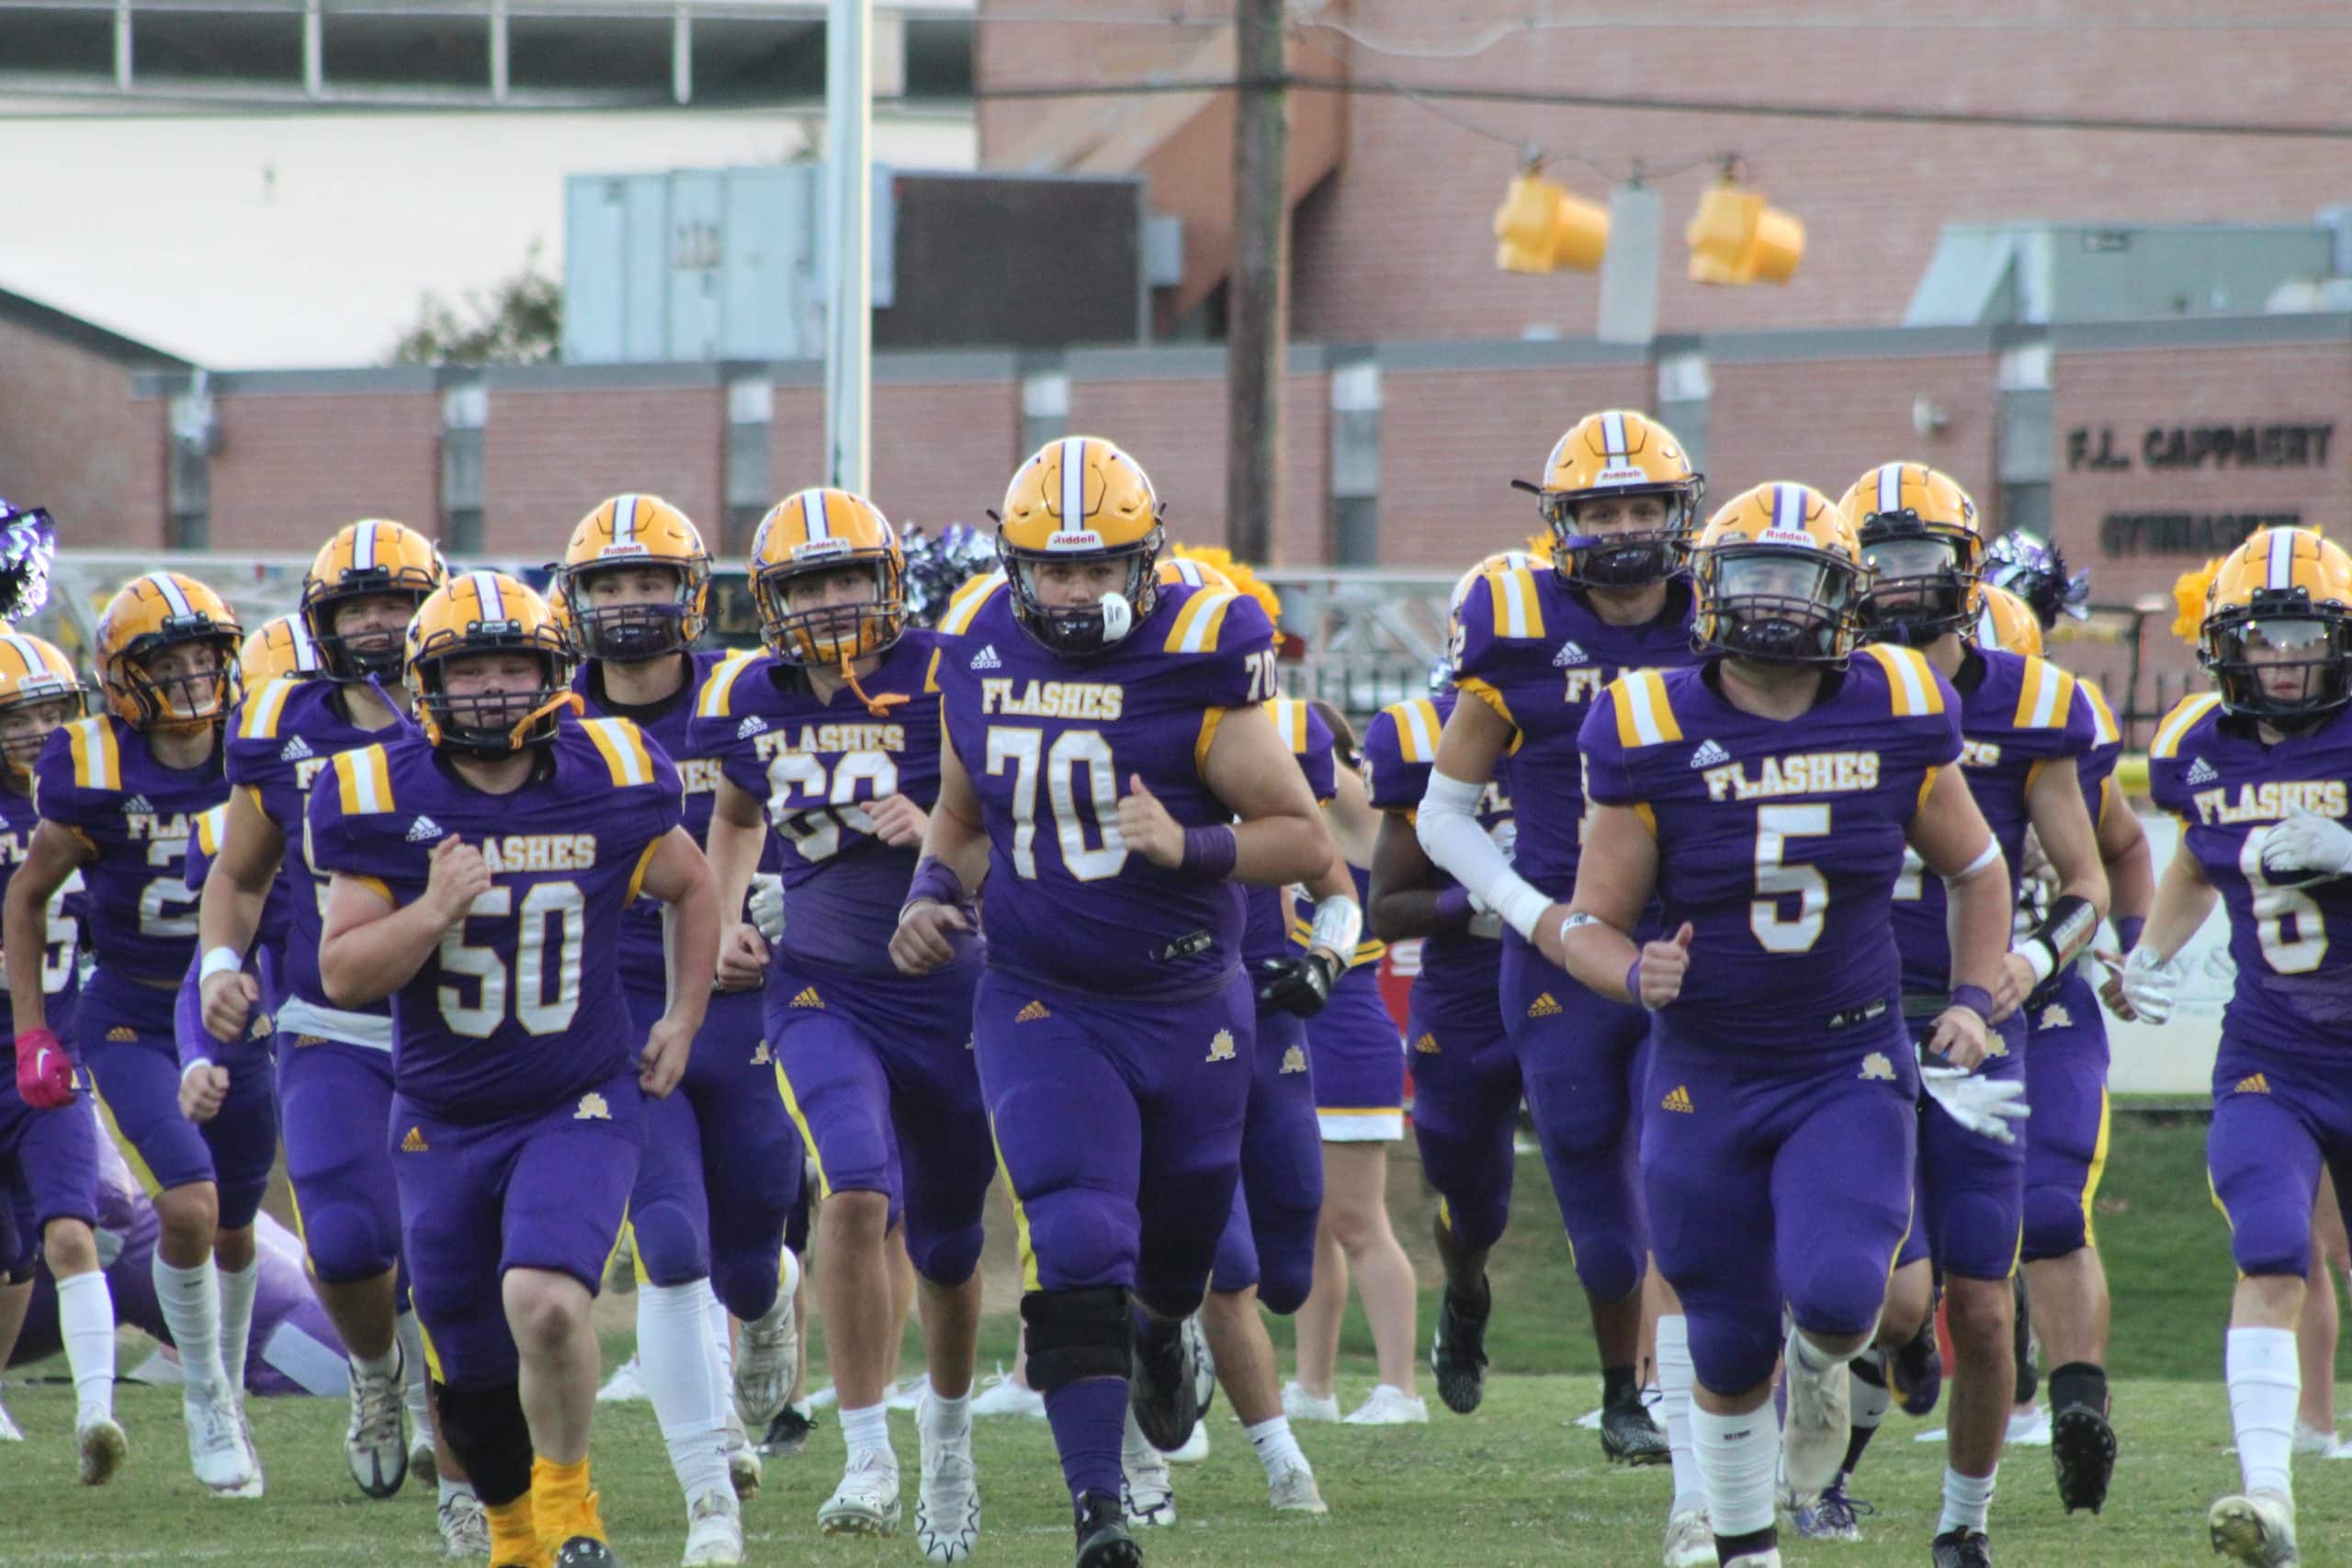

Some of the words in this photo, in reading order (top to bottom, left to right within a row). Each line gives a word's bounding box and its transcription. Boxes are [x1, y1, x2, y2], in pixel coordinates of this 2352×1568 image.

[1053, 536, 1095, 545] Riddell
[981, 678, 1124, 721] FLASHES
[1244, 649, 1276, 702] 70
[752, 723, 905, 761] FLASHES
[1702, 750, 1881, 802] FLASHES
[986, 725, 1129, 882] 70
[2192, 781, 2348, 826] FLASHES
[428, 834, 597, 874] ASHES
[1749, 803, 1831, 953] 5
[2239, 826, 2329, 976] 6
[436, 881, 586, 1039] 50
